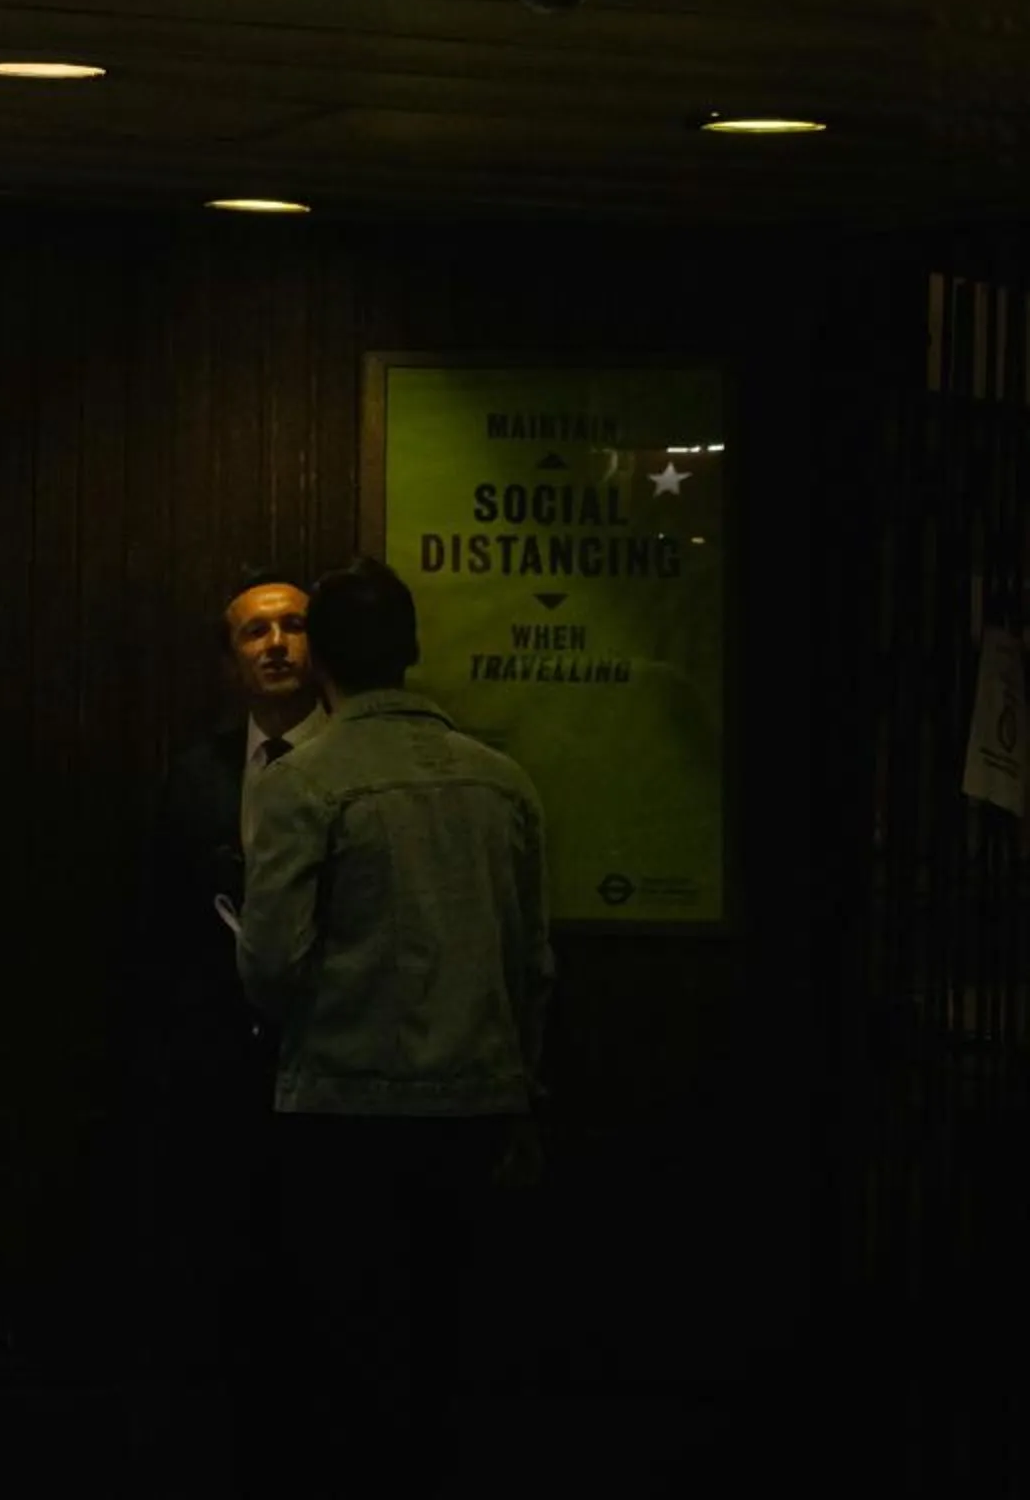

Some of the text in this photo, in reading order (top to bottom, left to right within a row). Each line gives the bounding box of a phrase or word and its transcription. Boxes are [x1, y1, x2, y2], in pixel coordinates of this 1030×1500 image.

[486, 412, 618, 441] MAINTAIN
[474, 484, 628, 527] SOCIAL
[421, 533, 681, 578] DISTANCING
[511, 624, 586, 651] WHEN
[471, 655, 632, 683] TRAVELLING
